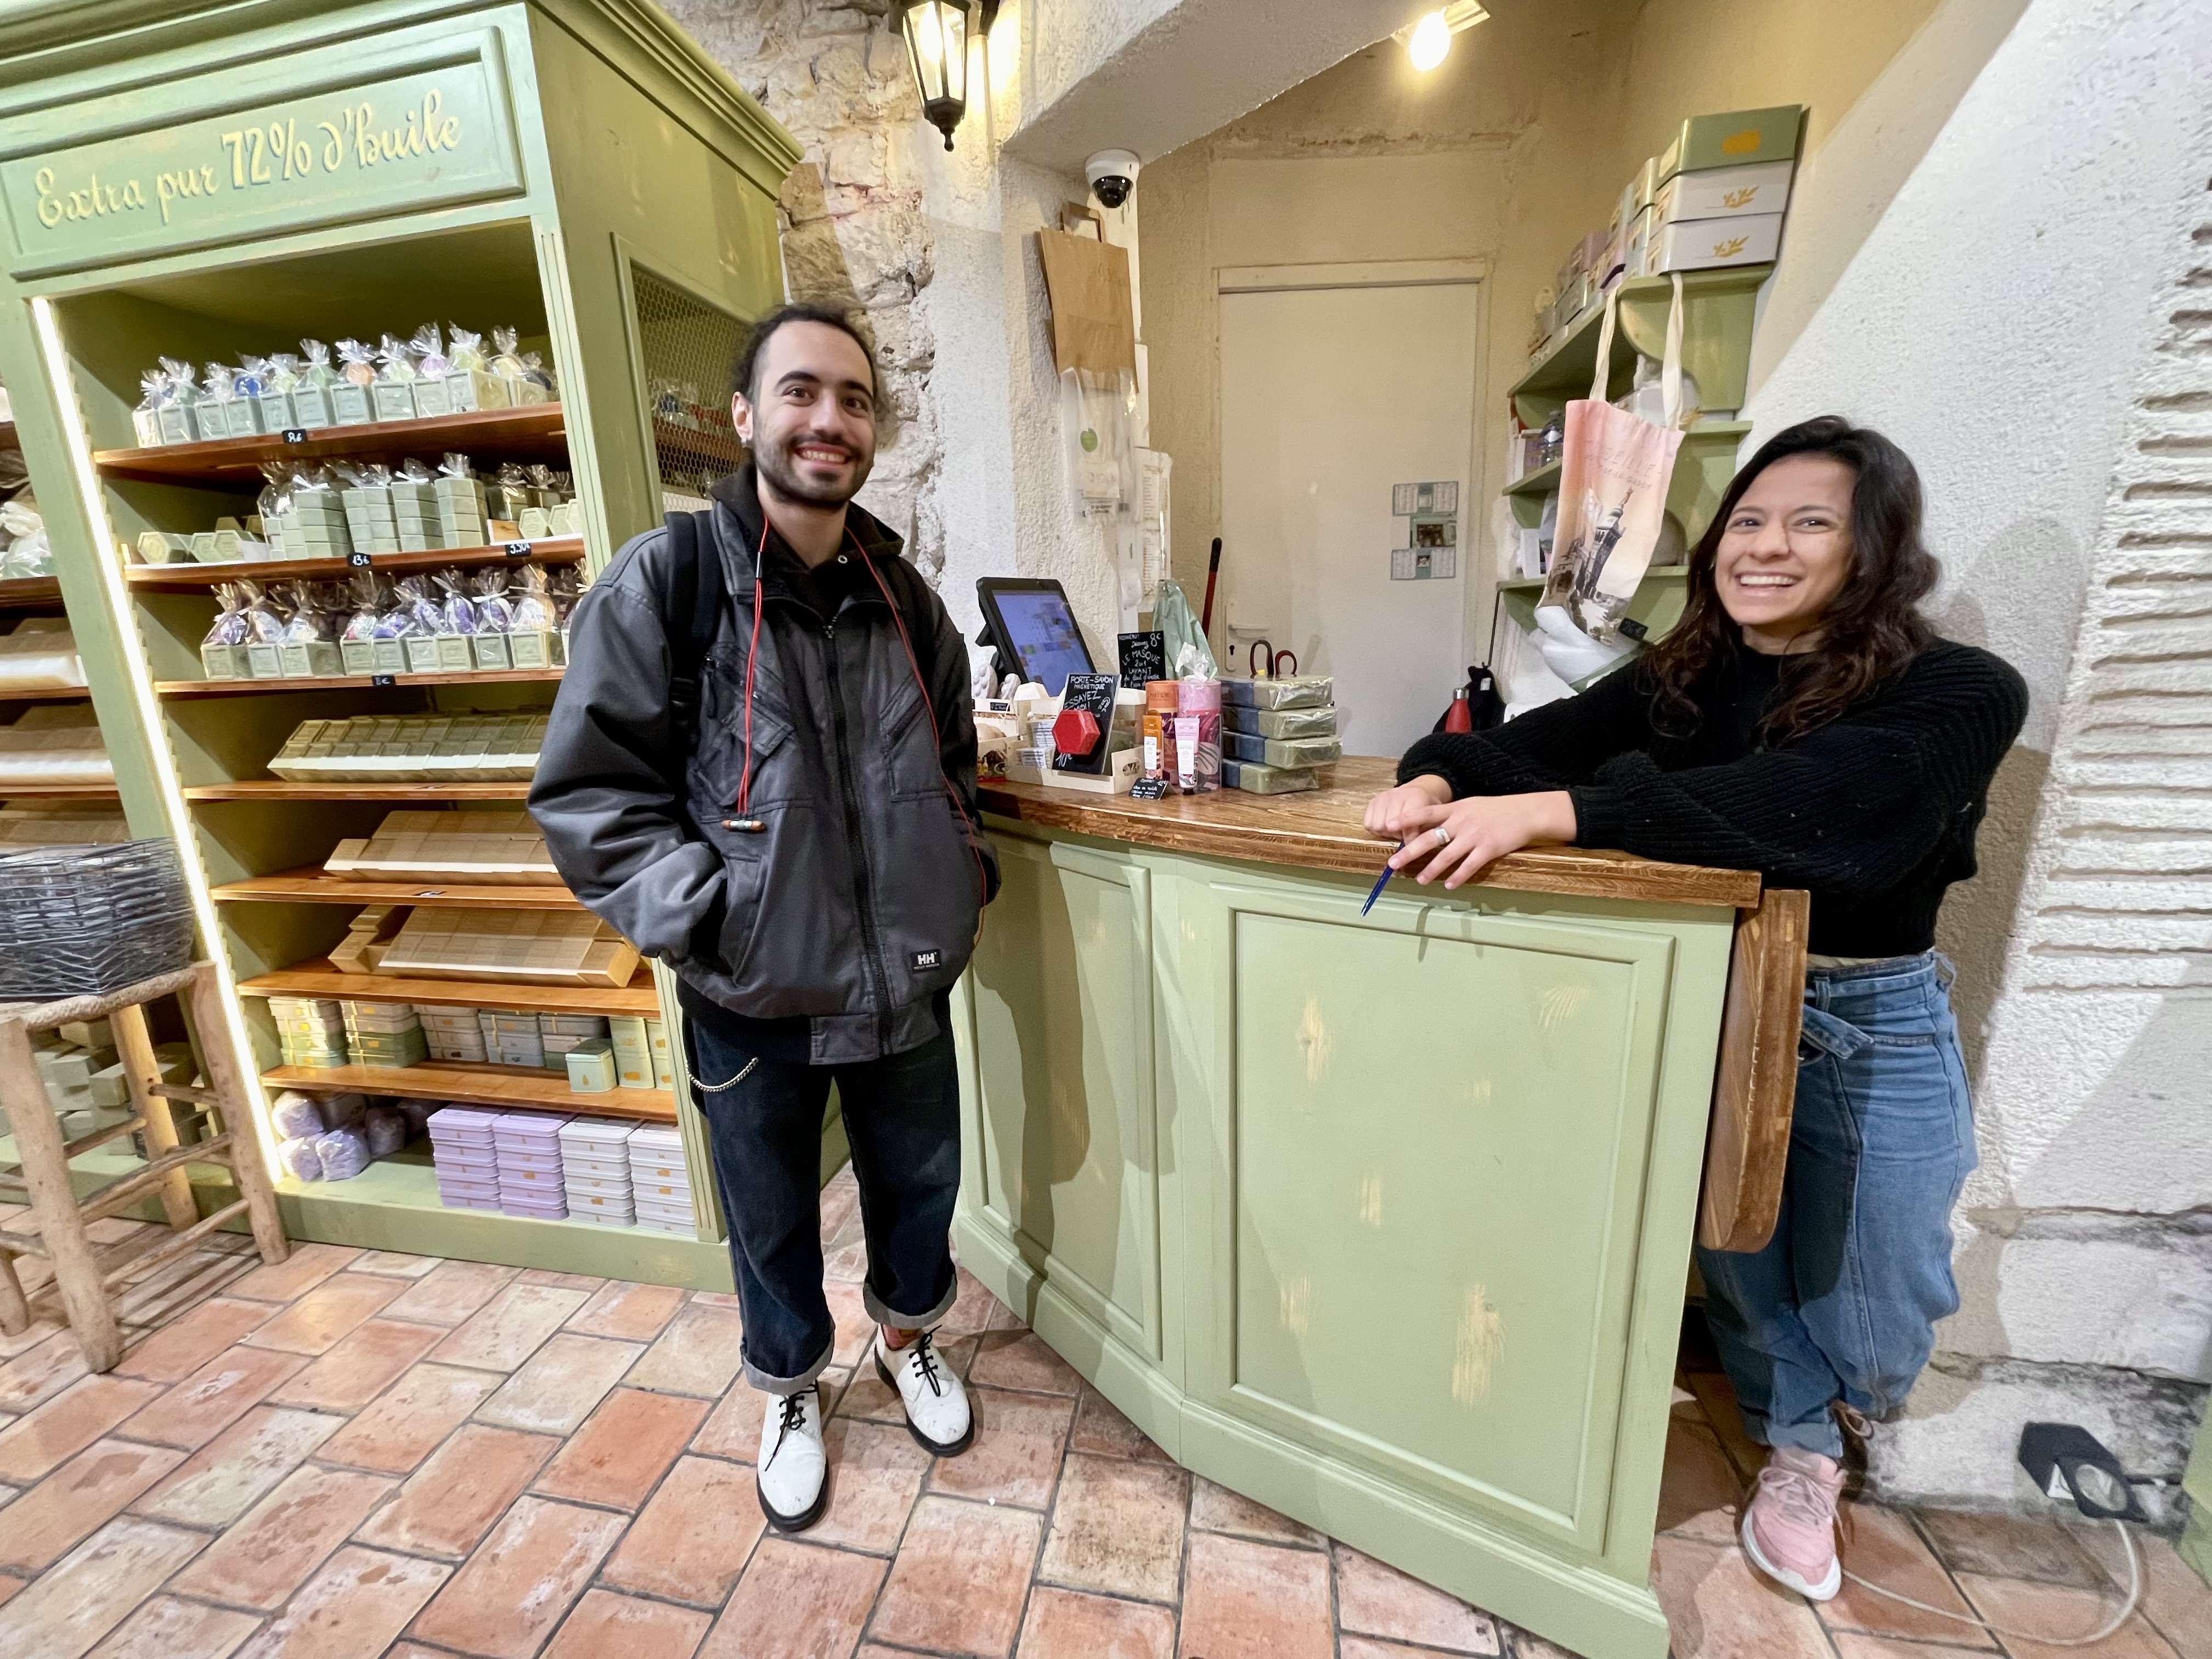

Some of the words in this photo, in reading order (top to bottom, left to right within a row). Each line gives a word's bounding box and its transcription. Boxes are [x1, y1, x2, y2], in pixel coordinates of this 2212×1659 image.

[35, 166, 146, 229] Extra
[156, 163, 220, 226] pur
[221, 117, 312, 189] 72%
[317, 88, 462, 172] d'huile
[1122, 653, 1130, 665] LE
[1132, 649, 1160, 664] MASQUE
[1064, 691, 1101, 709] ESSAYEZ
[917, 952, 935, 965] HH
